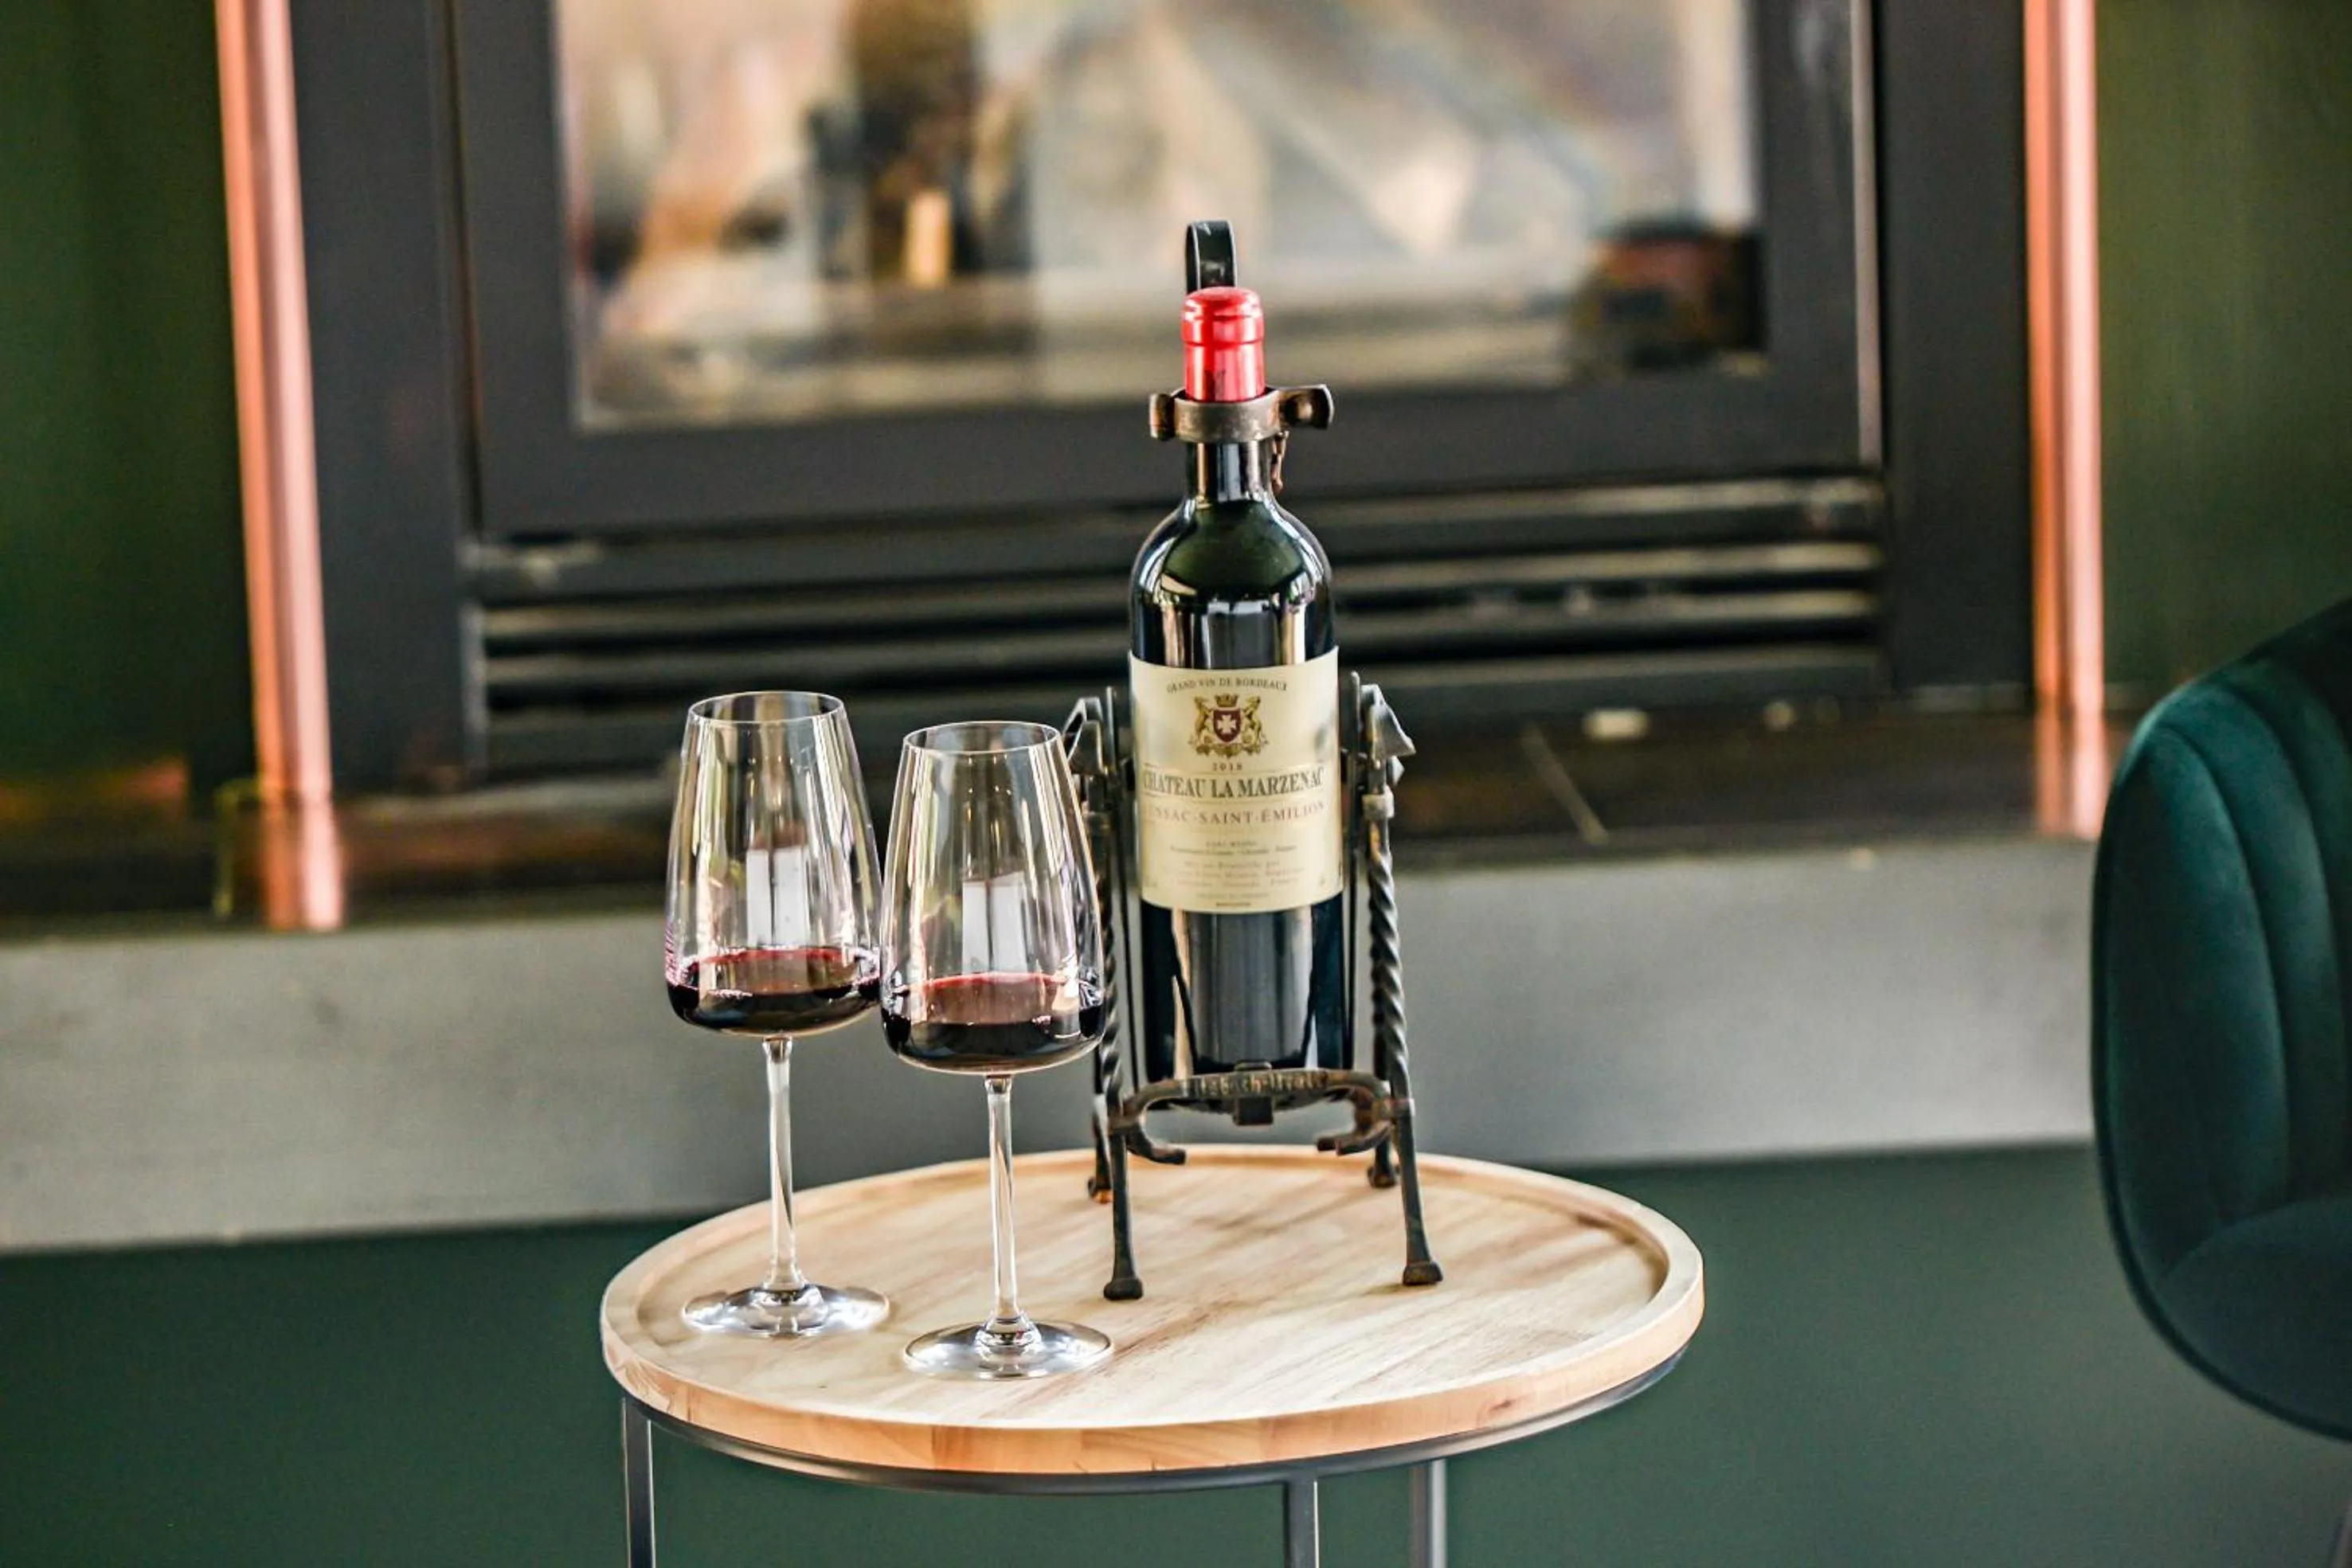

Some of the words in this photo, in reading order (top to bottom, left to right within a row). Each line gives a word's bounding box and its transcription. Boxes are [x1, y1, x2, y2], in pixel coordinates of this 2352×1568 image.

[1166, 679, 1196, 694] GRAND
[1199, 678, 1215, 687] VIN
[1219, 678, 1231, 686] DE
[1236, 677, 1287, 691] BORDEAUX
[1211, 778, 1234, 799] LA
[1237, 765, 1325, 798] MARZENAC
